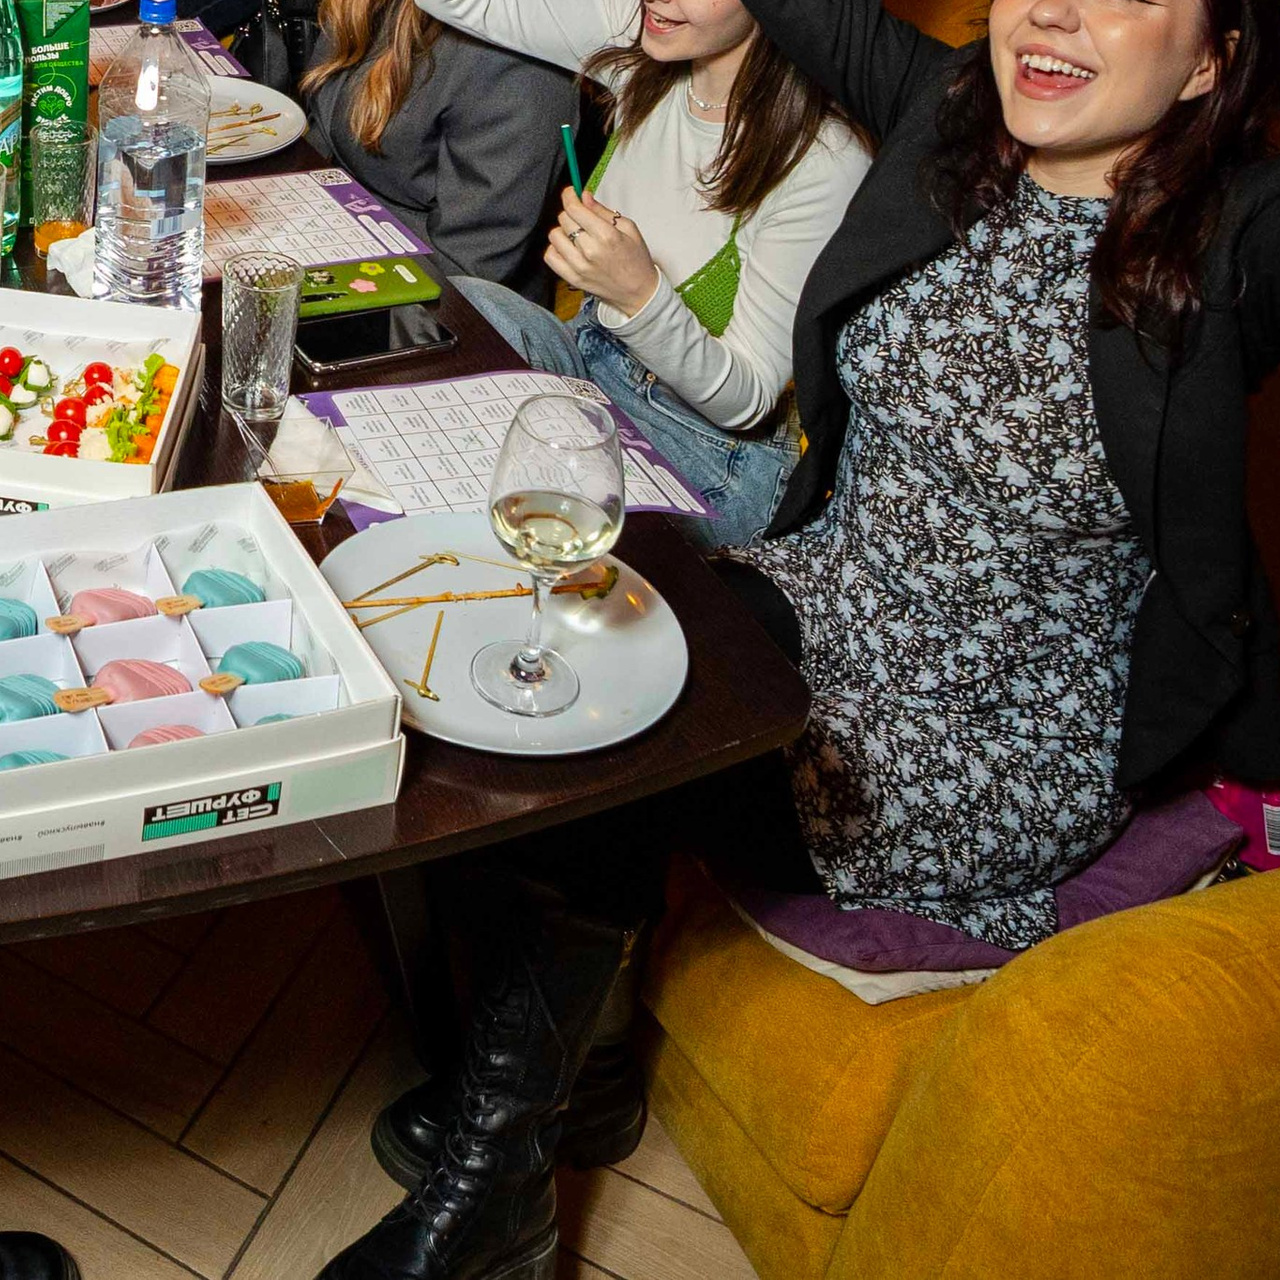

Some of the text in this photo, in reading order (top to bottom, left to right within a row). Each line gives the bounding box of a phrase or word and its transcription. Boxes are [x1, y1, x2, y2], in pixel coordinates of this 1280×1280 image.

[31, 42, 70, 55] БОЛЬШЕ
[25, 52, 60, 64] ПОЛЬЗЫ
[48, 60, 84, 68] ОБЩЕСТВА
[30, 85, 73, 107] РАСТИМ ДОБРО
[152, 788, 262, 822] ФУРШЕТ
[223, 803, 274, 824] СЕТ
[37, 820, 105, 838] #навыпускной
